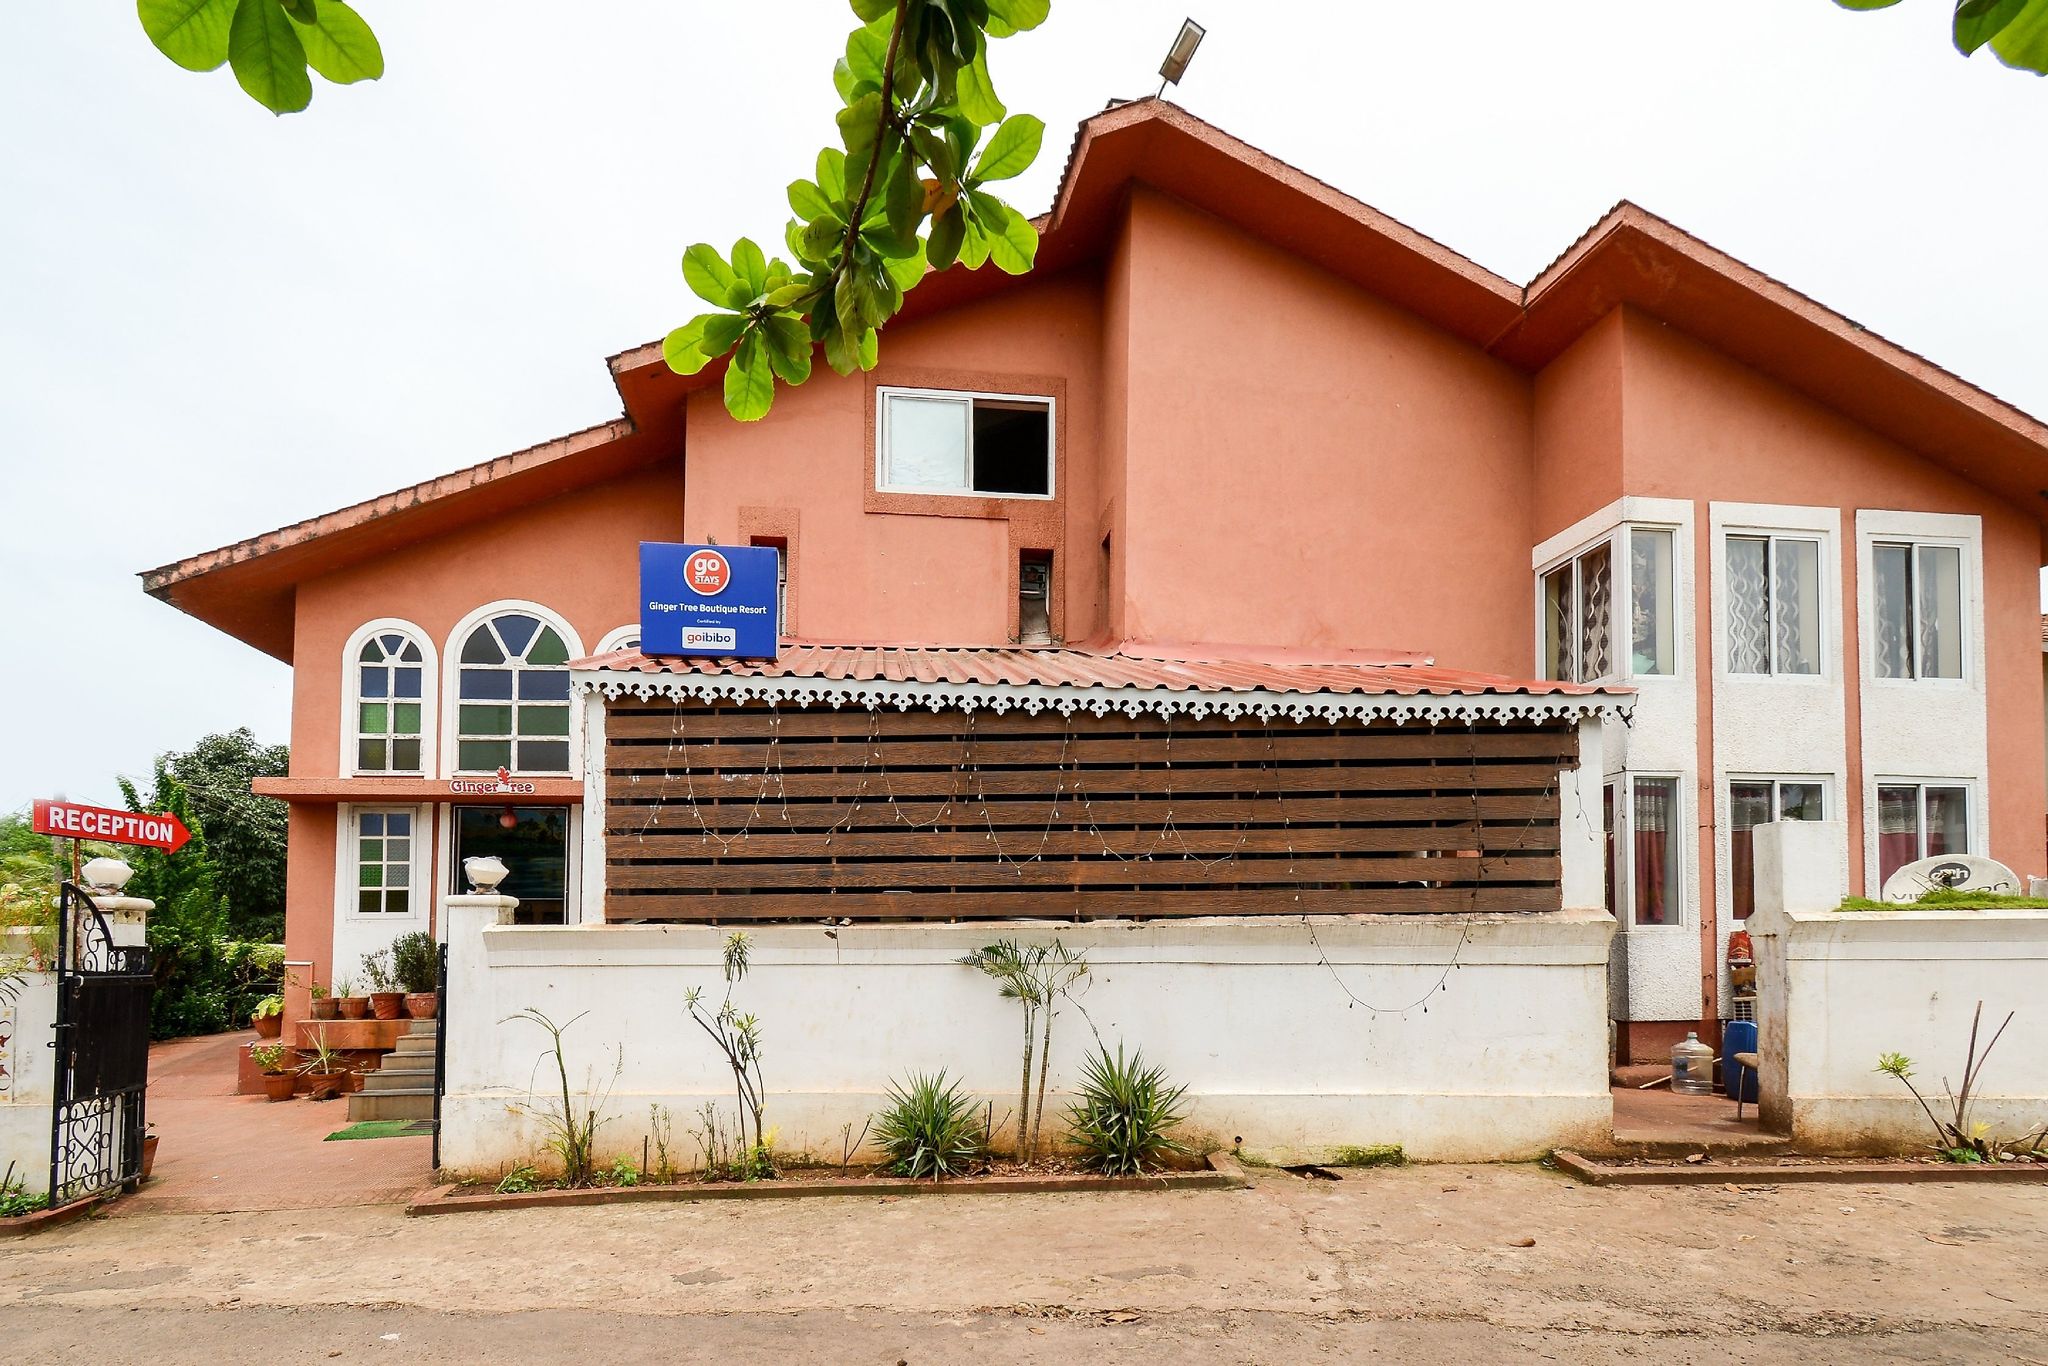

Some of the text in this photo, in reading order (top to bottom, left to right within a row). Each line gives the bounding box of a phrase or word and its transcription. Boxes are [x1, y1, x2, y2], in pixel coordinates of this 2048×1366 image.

[694, 558, 720, 576] go
[694, 576, 720, 585] STAYS
[649, 602, 767, 615] Ginger Tree Boutique Resort
[687, 632, 731, 644] goibibo
[451, 781, 498, 793] Ginger
[49, 806, 173, 843] RECEPTION
